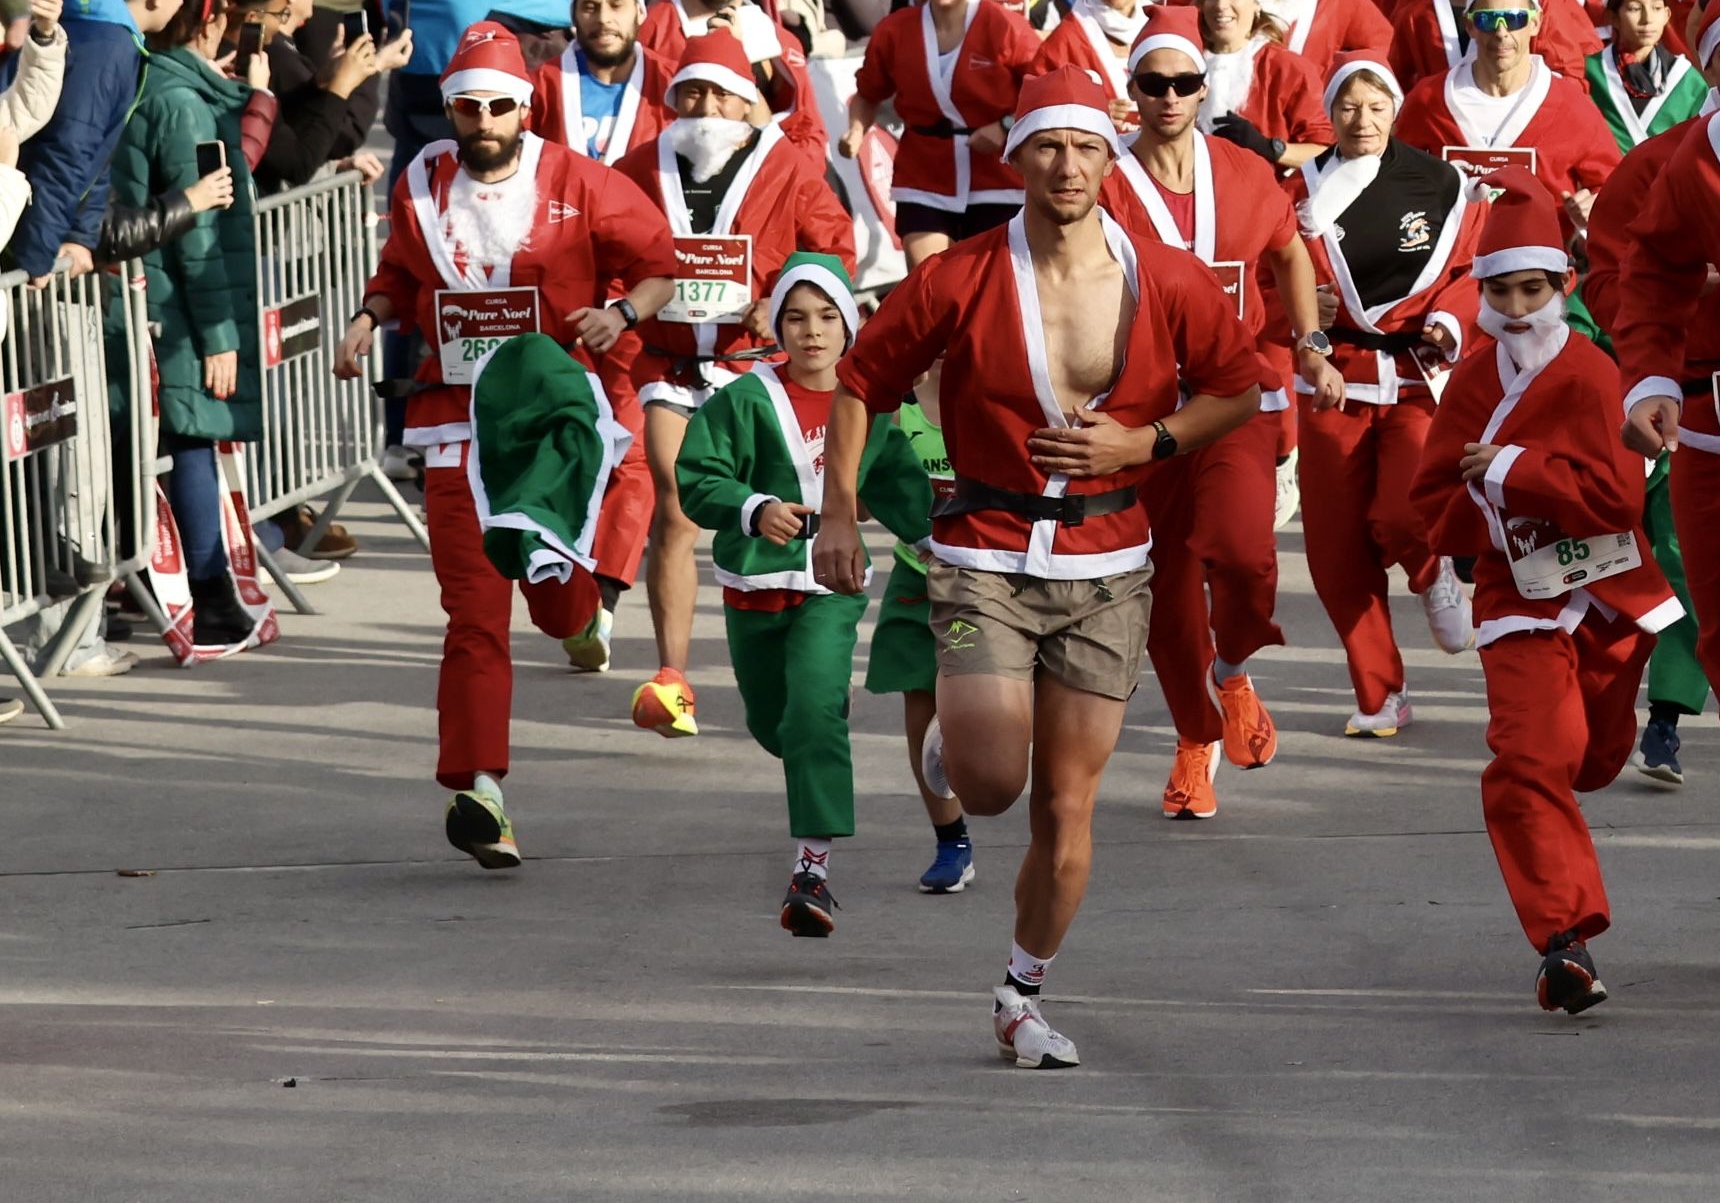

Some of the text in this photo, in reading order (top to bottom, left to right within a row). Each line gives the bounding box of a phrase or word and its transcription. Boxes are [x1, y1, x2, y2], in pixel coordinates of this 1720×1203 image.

[1473, 164, 1500, 175] Par
[684, 253, 745, 266] Pare Noel
[676, 281, 727, 303] 1377
[467, 306, 532, 321] Pare Noel
[479, 324, 521, 333] BARCELONA
[1554, 538, 1591, 567] 85
